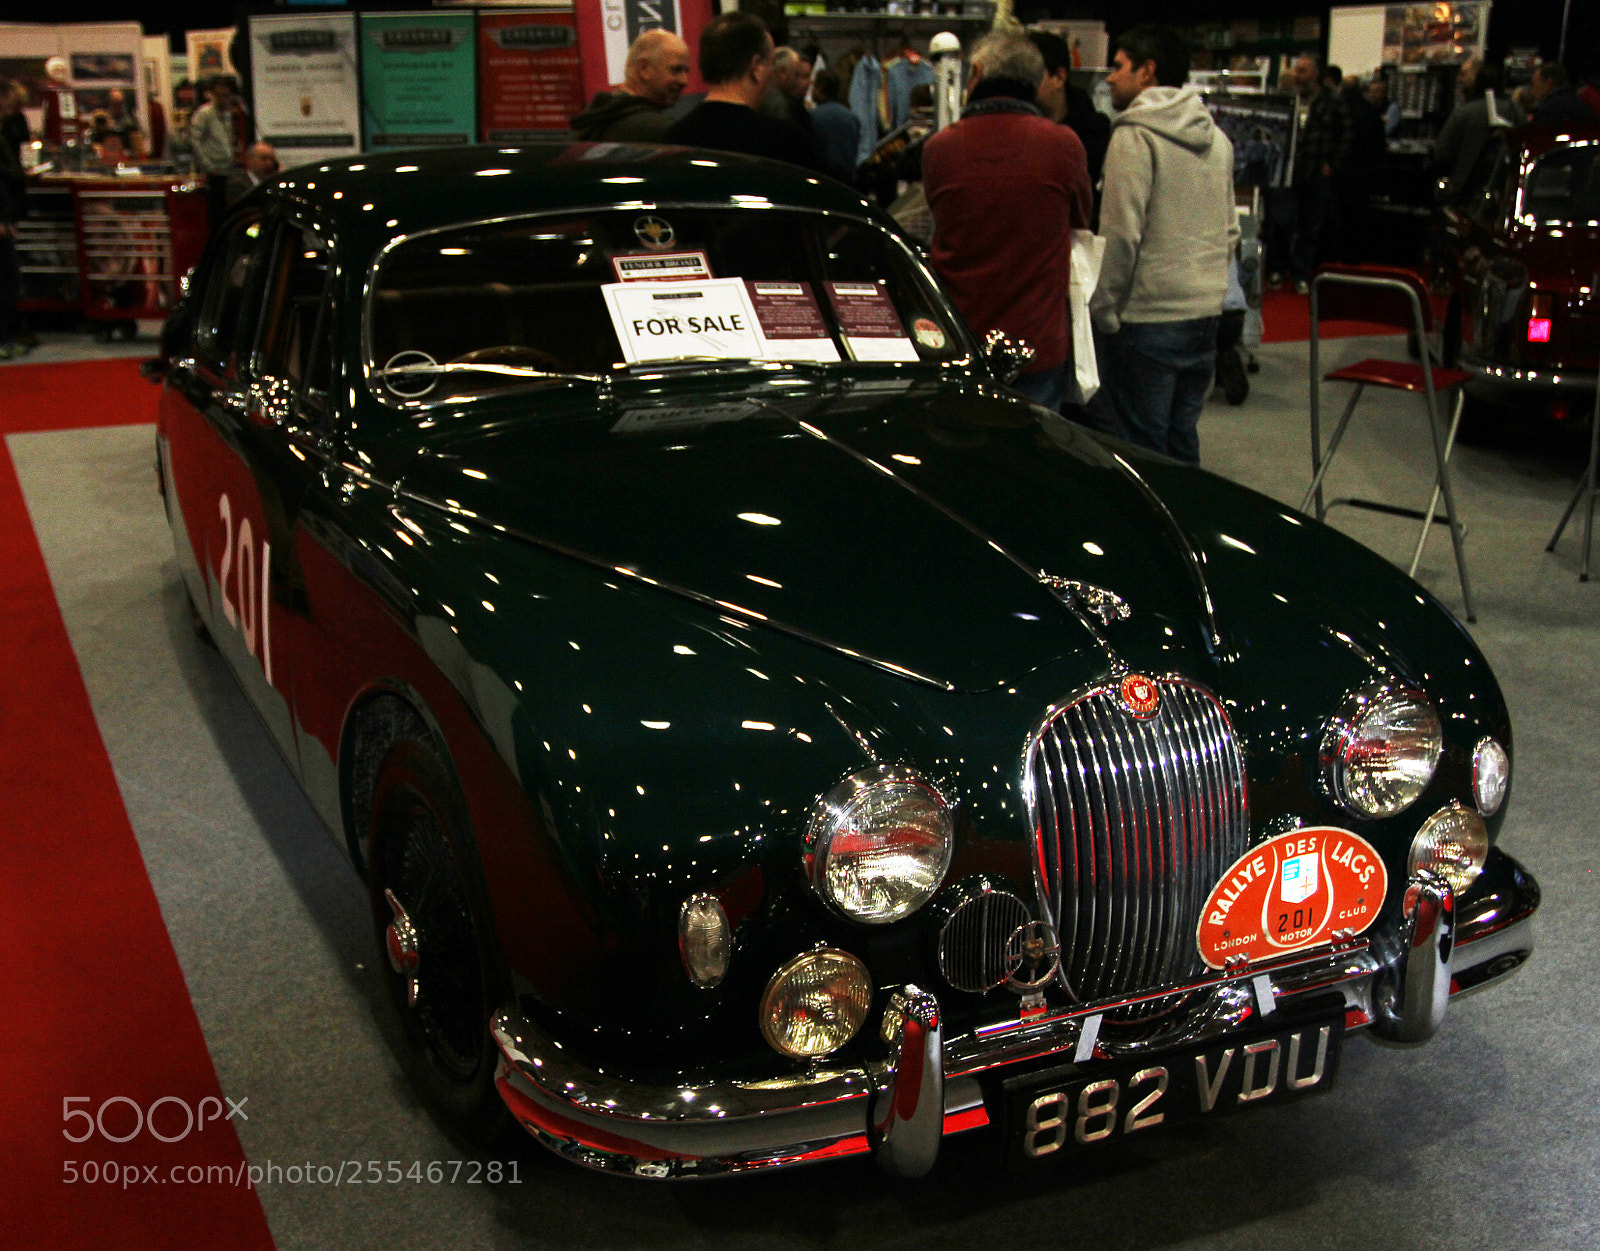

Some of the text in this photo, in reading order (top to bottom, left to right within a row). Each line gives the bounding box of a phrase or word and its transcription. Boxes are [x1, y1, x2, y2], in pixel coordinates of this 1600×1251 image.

[633, 318, 683, 336] FOR
[688, 314, 745, 333] SALE
[219, 493, 272, 686] 201
[1208, 855, 1267, 926] RALLYE
[1285, 837, 1317, 858] DES
[1214, 905, 1367, 952] LONDON MOTOR CLUB
[1278, 908, 1313, 933] 201
[1024, 1026, 1330, 1158] 882 VDU
